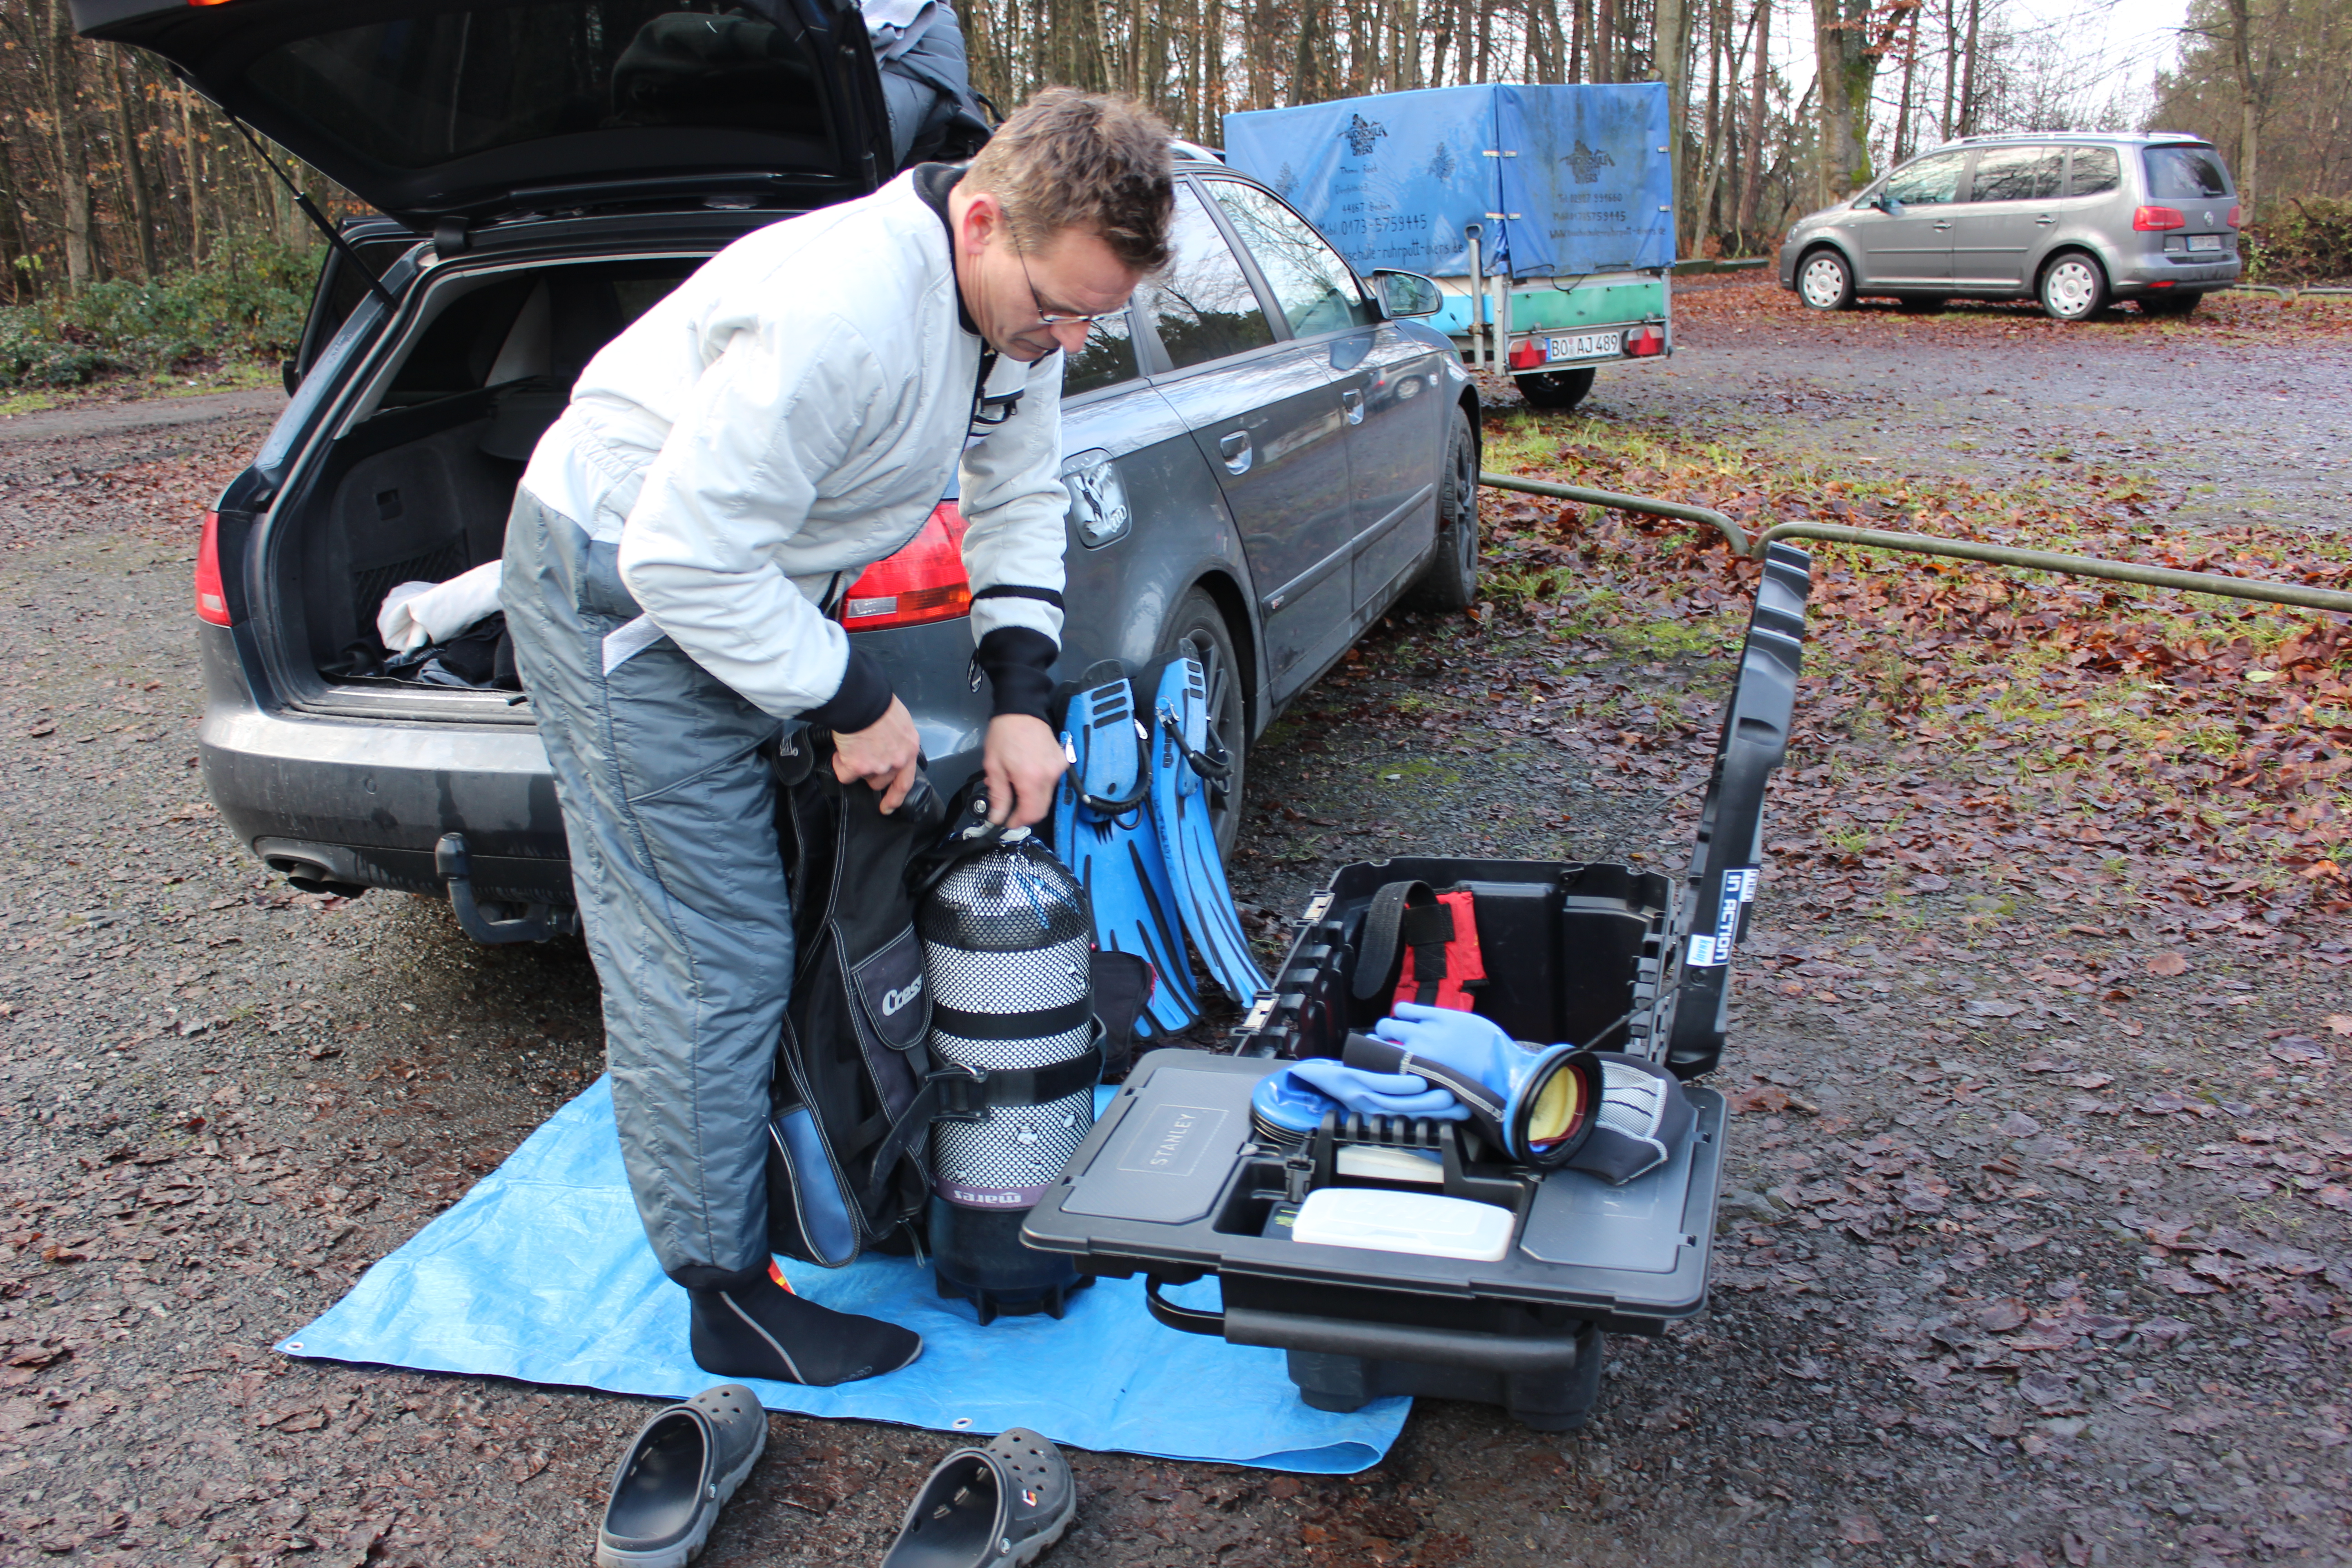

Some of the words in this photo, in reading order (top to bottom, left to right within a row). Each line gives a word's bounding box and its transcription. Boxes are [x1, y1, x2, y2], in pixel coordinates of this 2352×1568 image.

[1552, 340, 1568, 357] BO
[1577, 337, 1592, 355] AJ
[1596, 334, 1618, 352] 489
[1725, 874, 1742, 892] IN
[1714, 898, 1738, 961] ACTION
[1149, 1113, 1196, 1166] STANLEY
[954, 1190, 1021, 1204] mares
